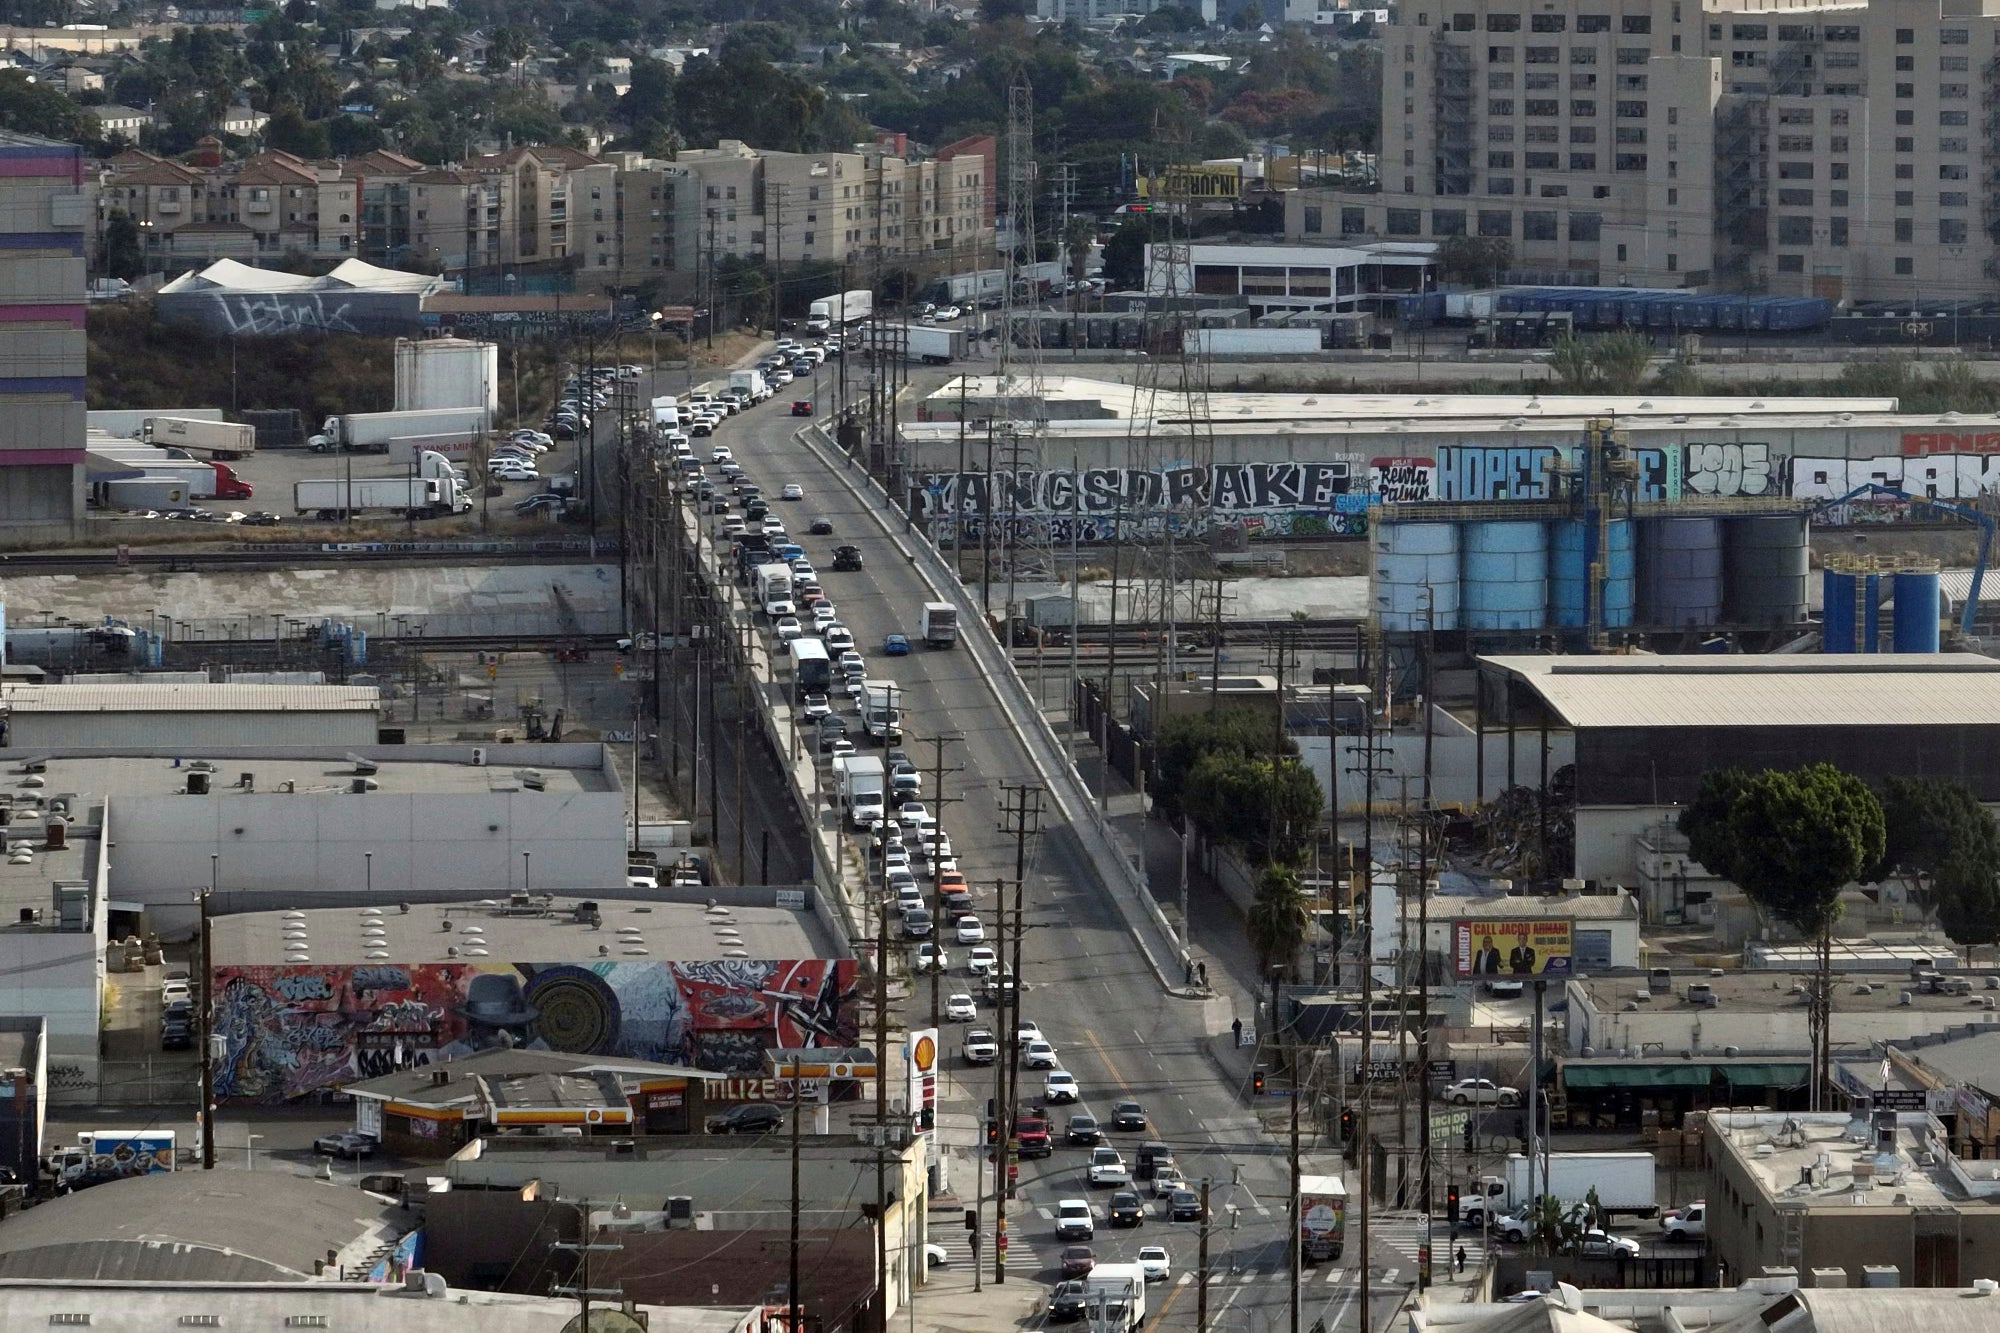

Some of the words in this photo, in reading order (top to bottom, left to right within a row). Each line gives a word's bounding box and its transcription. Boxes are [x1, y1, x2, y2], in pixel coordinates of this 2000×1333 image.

[1438, 446, 1560, 500] HOPES
[322, 543, 382, 552] LOST
[1474, 923, 1496, 935] CALL
[1499, 923, 1530, 935] JACOB
[1458, 926, 1470, 971] INJURED?
[1430, 1112, 1468, 1127] ERCDO
